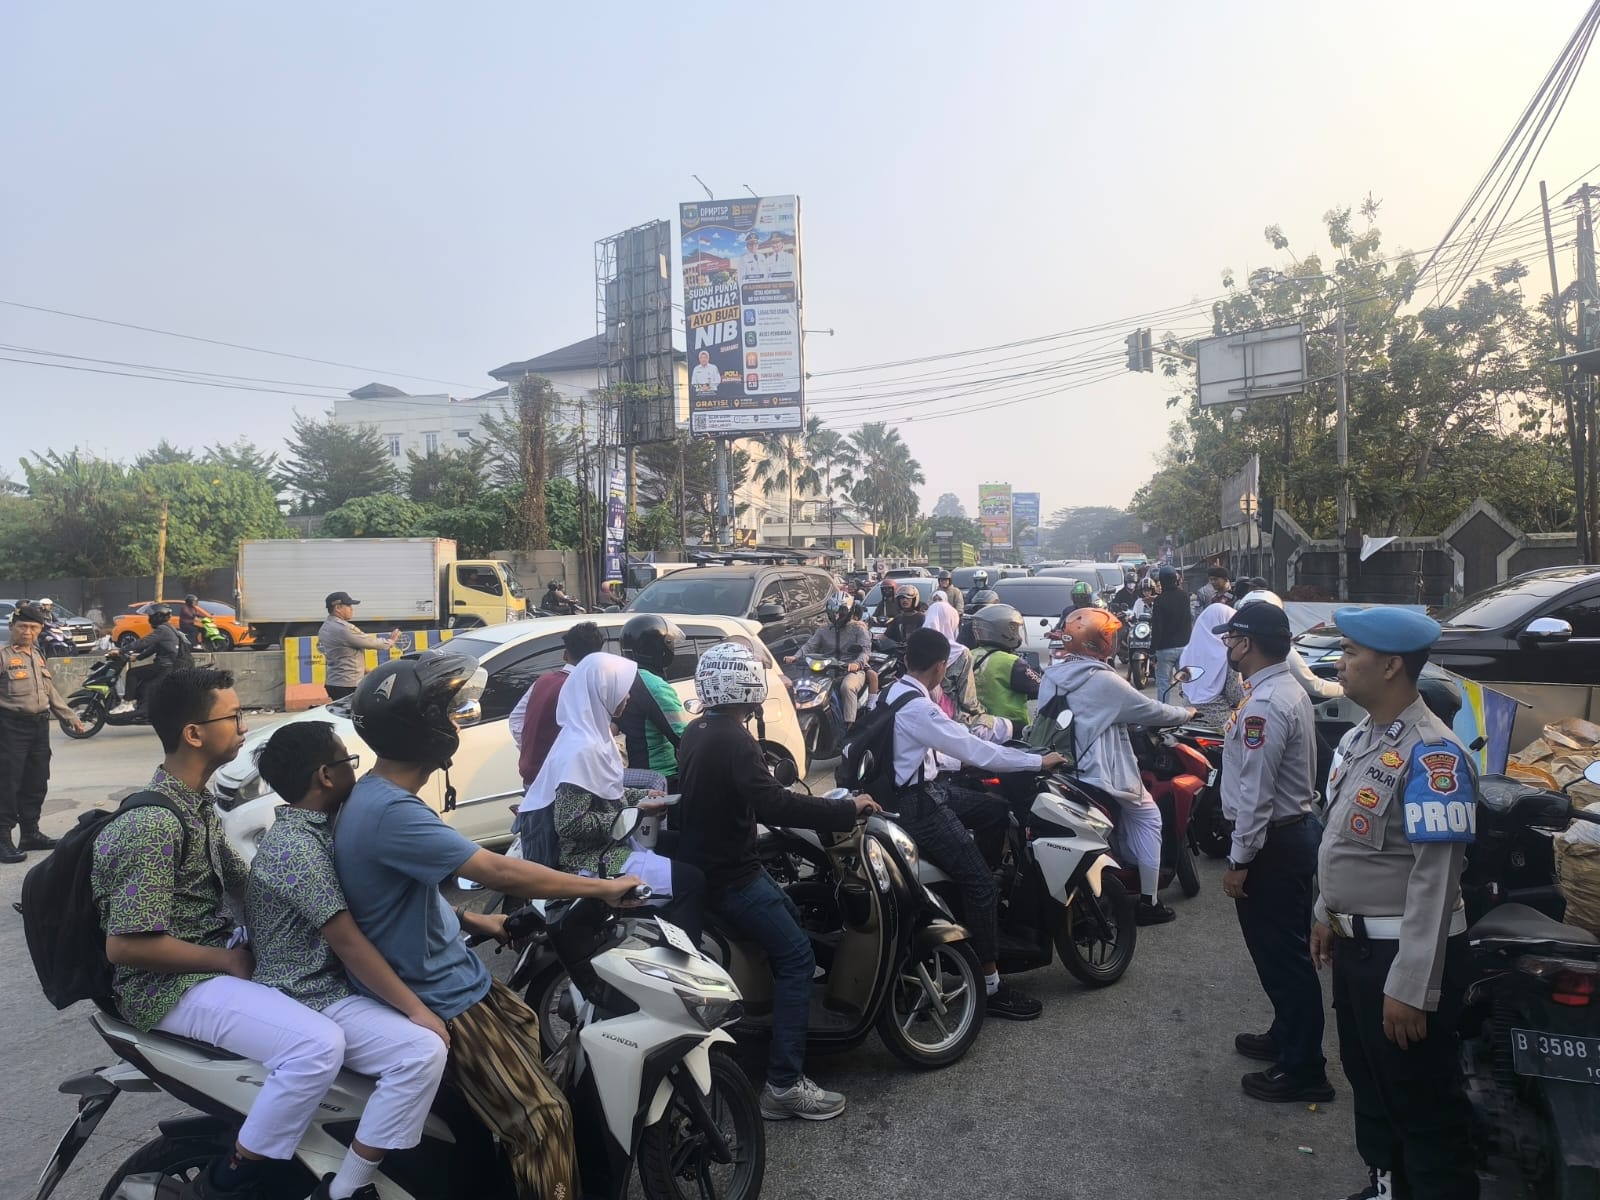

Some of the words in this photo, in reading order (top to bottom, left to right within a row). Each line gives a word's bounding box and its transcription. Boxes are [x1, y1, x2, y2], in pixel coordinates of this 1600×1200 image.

[689, 286, 713, 299] SUDAH
[715, 283, 738, 295] PUNYA
[692, 292, 736, 313] USAHA?
[693, 313, 712, 326] AYO
[715, 308, 739, 321] BUAT
[695, 320, 738, 349] NIB
[1366, 766, 1396, 788] POLRI
[601, 1031, 639, 1049] HONDA
[1517, 1033, 1528, 1050] B
[1538, 1036, 1587, 1058] 3588
